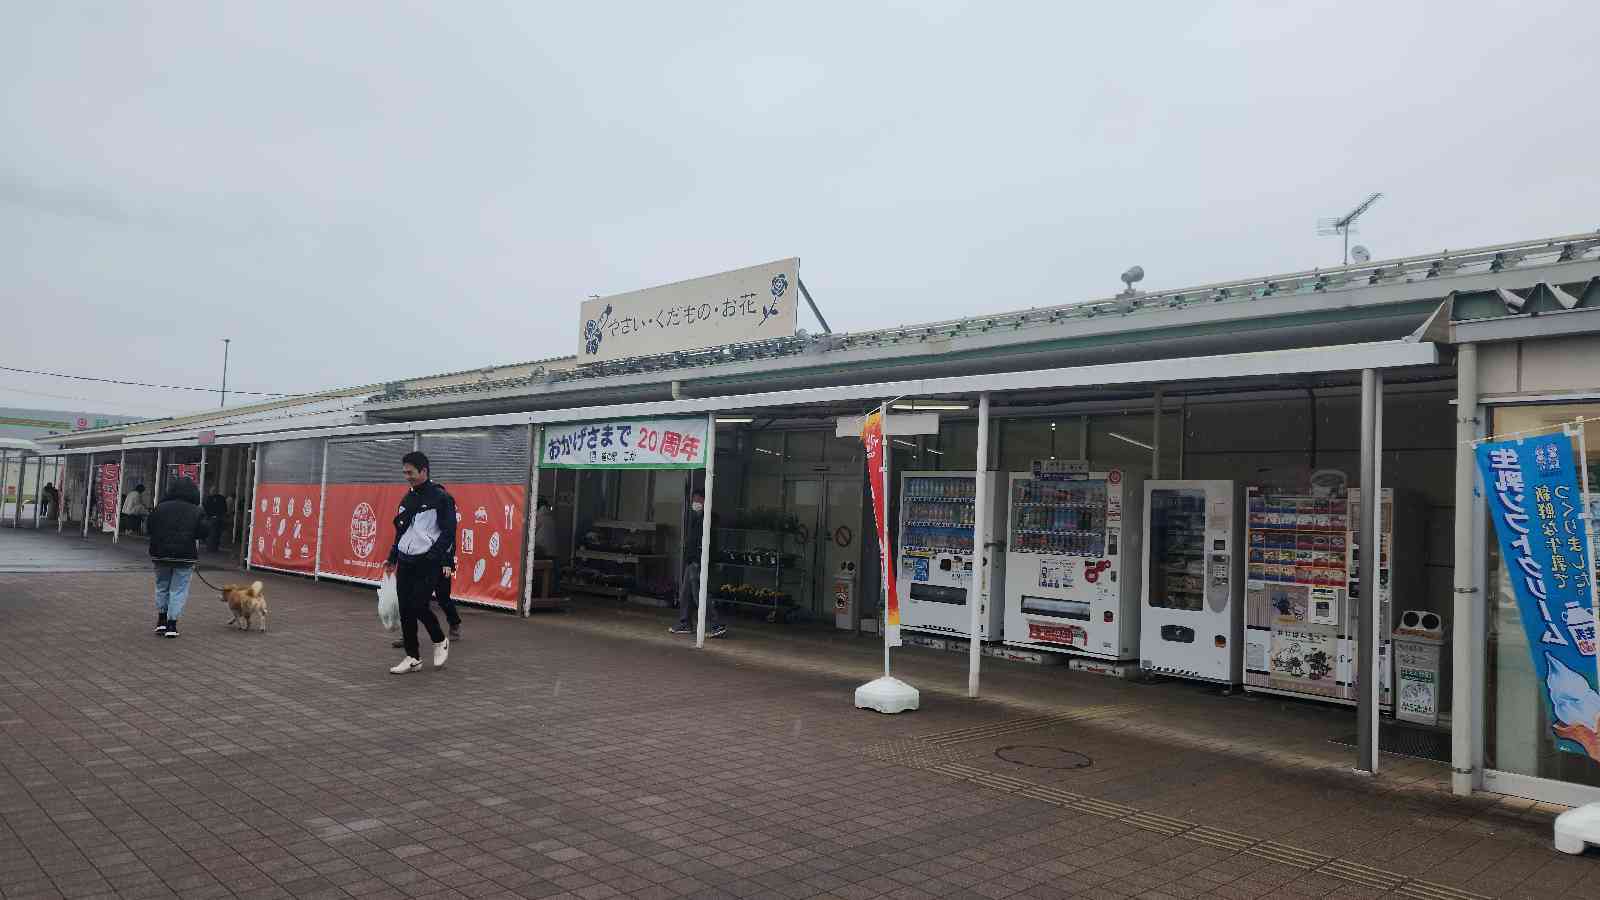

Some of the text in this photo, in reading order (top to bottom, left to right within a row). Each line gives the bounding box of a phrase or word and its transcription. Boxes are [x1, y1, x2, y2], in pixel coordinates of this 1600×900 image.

[608, 293, 758, 337] やさい・くだもの・お花
[547, 424, 701, 461] おかげさまで 20周年
